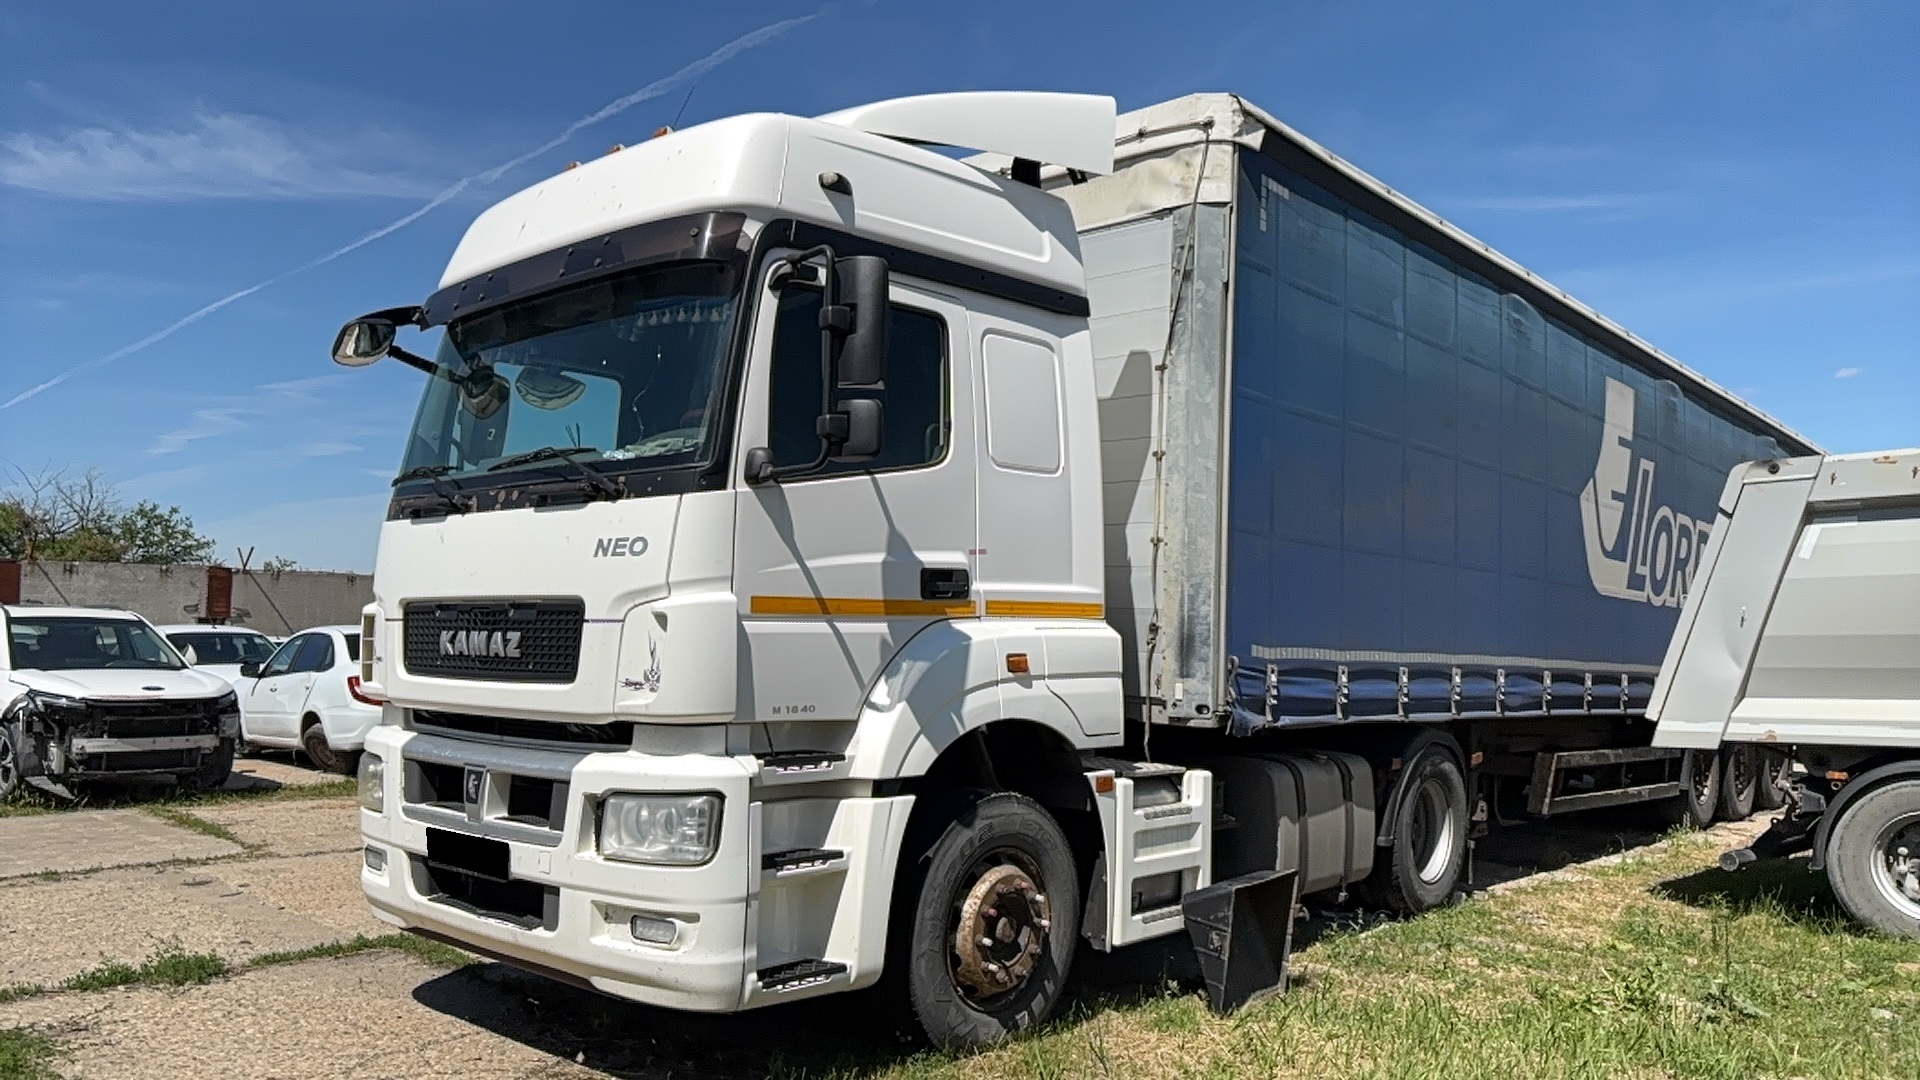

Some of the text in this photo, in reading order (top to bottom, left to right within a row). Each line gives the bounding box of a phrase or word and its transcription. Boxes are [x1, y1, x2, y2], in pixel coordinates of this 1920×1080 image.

[593, 536, 649, 557] NEO
[440, 630, 522, 658] KAMAZ
[772, 704, 816, 715] M 1840
